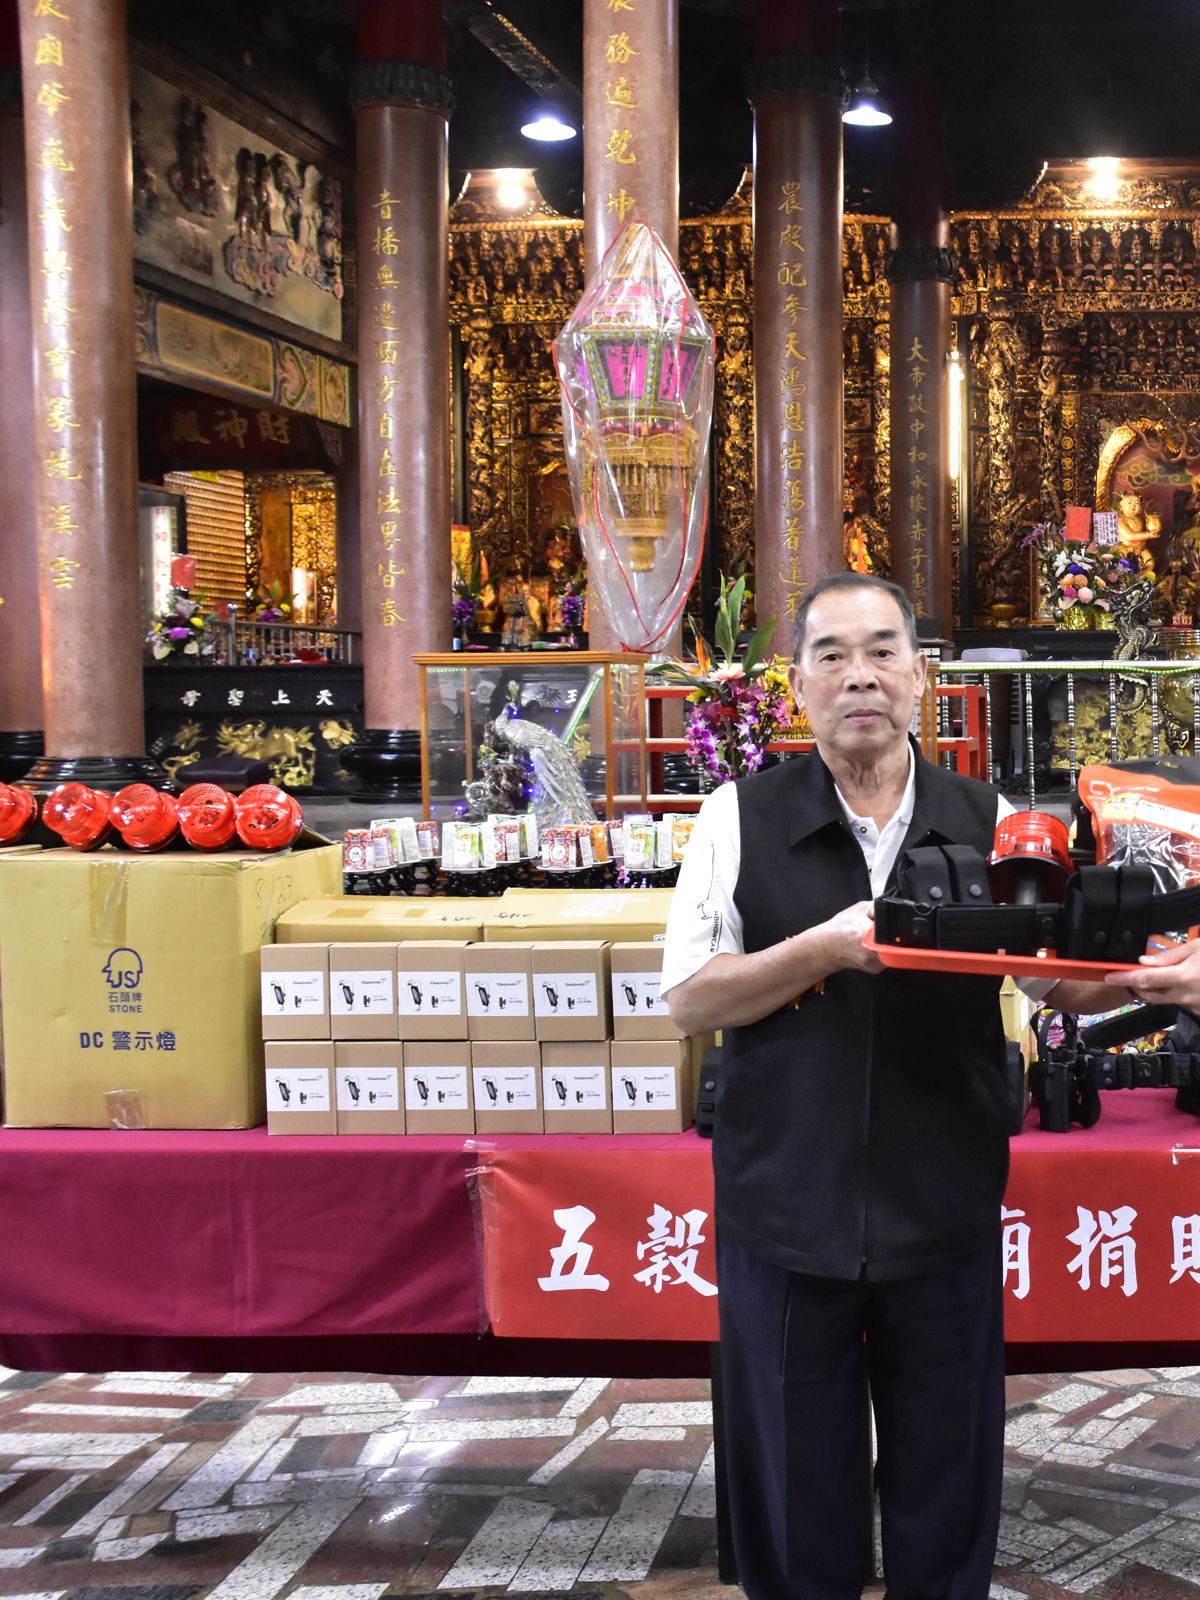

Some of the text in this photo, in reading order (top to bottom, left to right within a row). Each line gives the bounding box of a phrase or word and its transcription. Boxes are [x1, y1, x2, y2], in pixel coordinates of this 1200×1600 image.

[108, 992, 142, 1002] 石頭牌
[109, 1005, 142, 1013] STONE
[80, 1031, 176, 1051] DC 警示燈
[536, 1204, 718, 1295] 五穀
